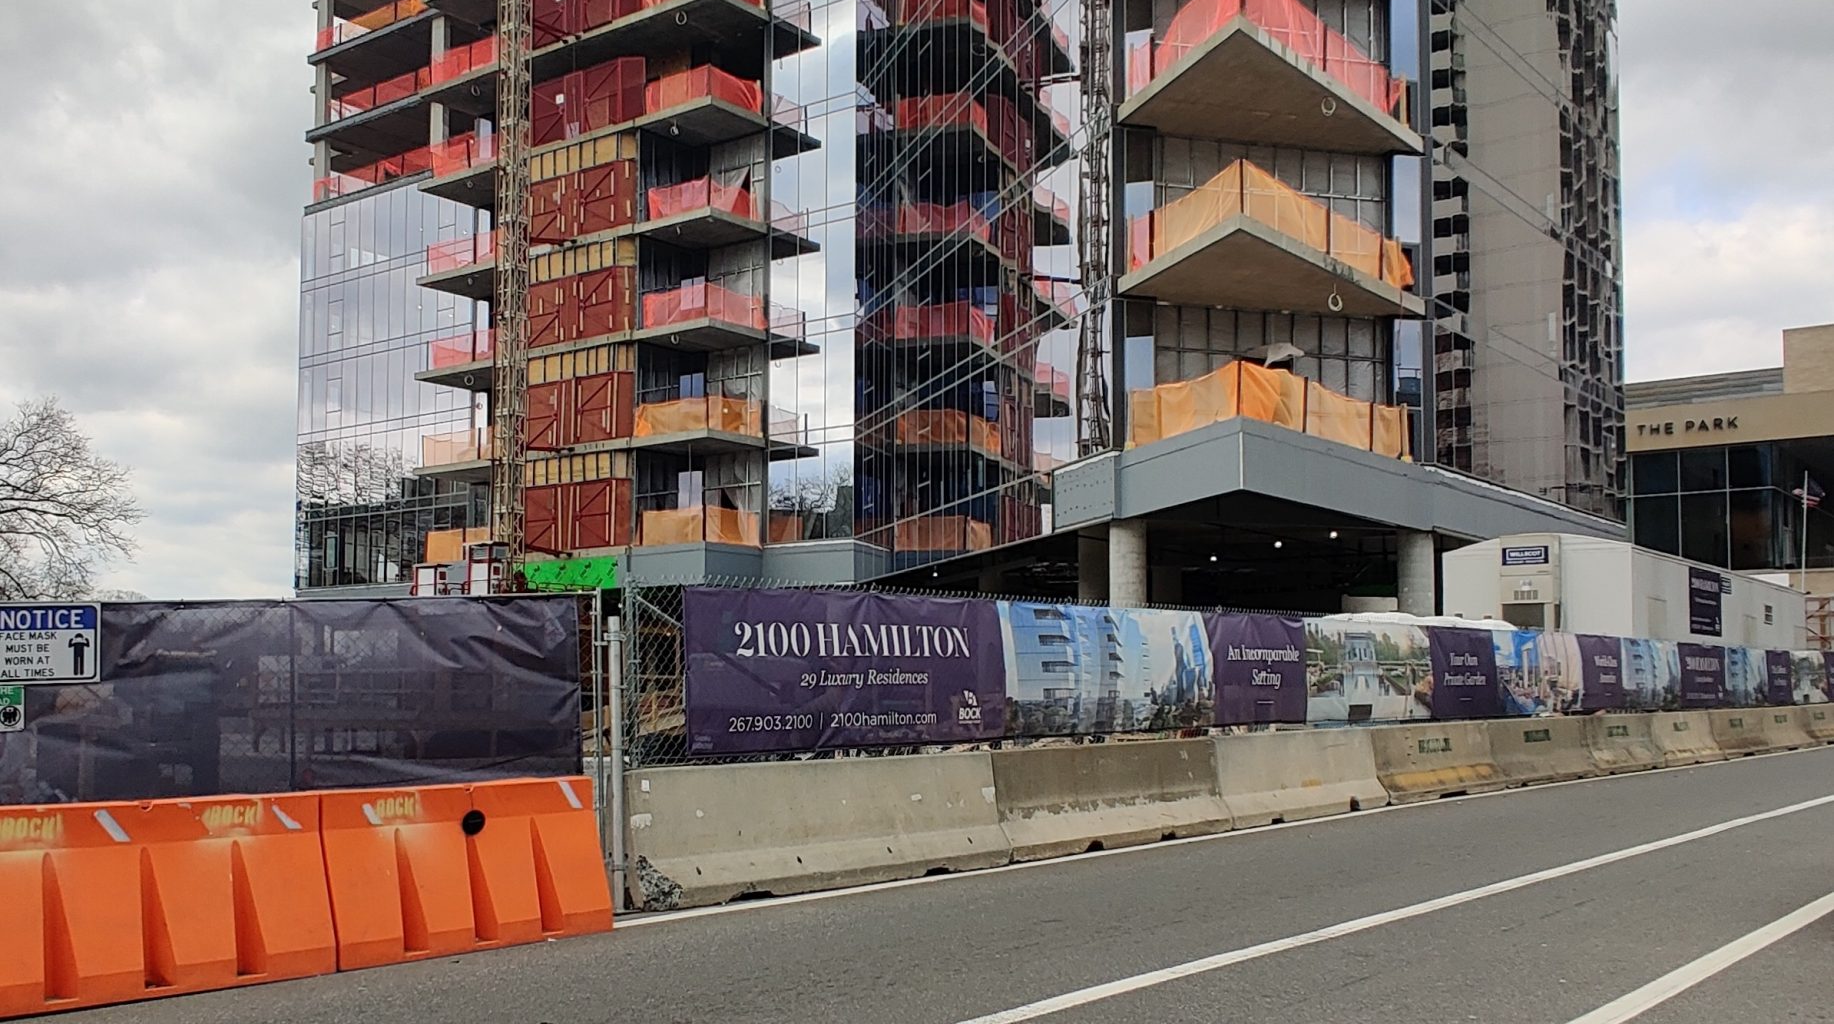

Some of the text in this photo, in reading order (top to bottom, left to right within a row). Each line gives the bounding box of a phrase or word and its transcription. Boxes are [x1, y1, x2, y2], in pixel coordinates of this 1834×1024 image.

[1636, 416, 1739, 436] THE PARK
[0, 609, 85, 630] NOTICE
[0, 631, 57, 641] FACE MASK
[734, 621, 970, 658] 2100 HAMILTON
[5, 643, 50, 653] MUST BE
[1227, 644, 1300, 665] An Incomparable
[5, 656, 50, 666] WORN AT
[0, 668, 55, 678] ALL TIMES
[800, 668, 929, 689] 29 Luxury Residences
[1251, 668, 1281, 690] Setting
[728, 711, 937, 732] 267.903.2100 2100hamilton.com
[958, 707, 982, 720] BOCK
